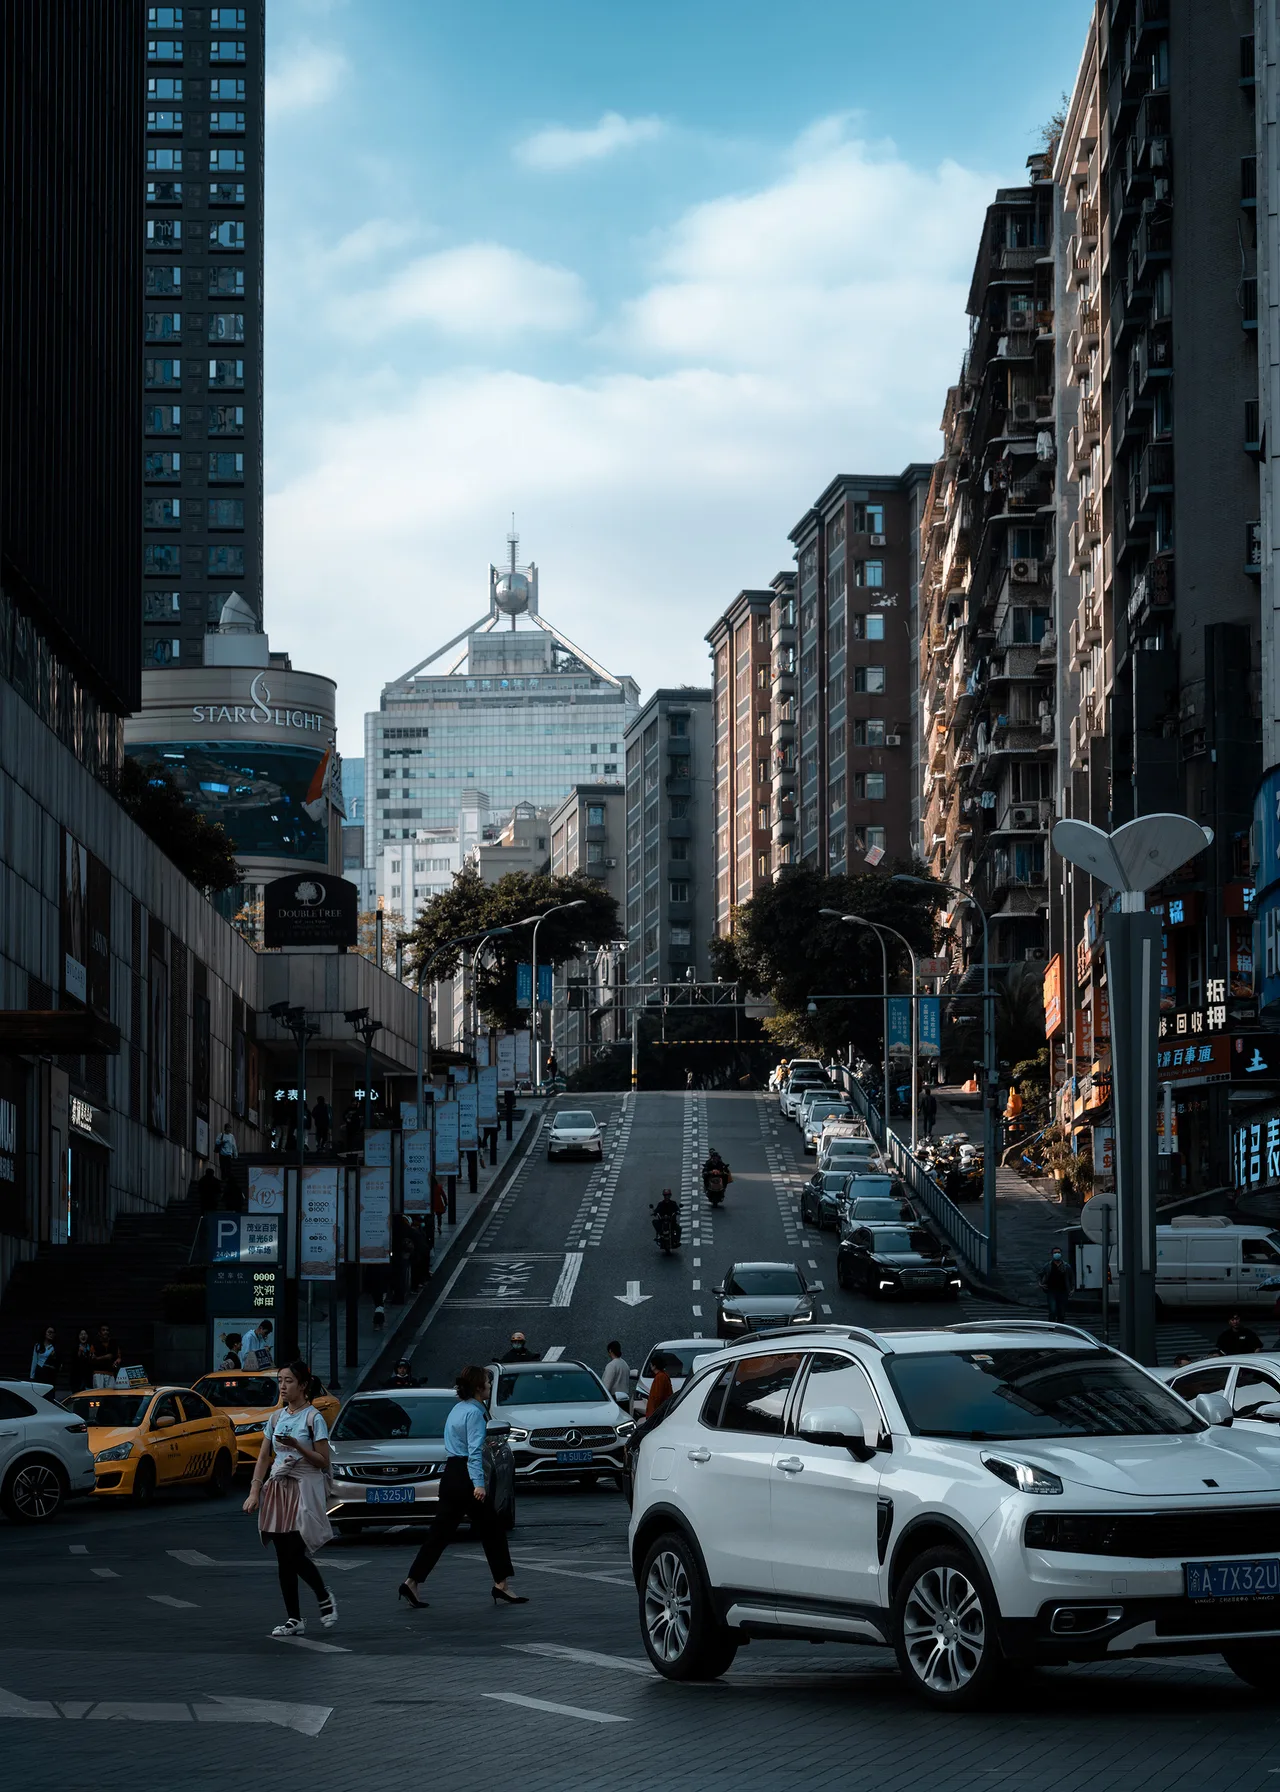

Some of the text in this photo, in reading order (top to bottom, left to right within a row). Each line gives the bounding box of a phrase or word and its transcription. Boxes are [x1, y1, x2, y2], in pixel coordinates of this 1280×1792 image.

[192, 705, 324, 732] STAR LIGHT
[1206, 978, 1227, 1031] 抵押
[1245, 1048, 1268, 1073] 土
[354, 1089, 379, 1101] 中心
[217, 1219, 238, 1248] P
[246, 1223, 277, 1232] 茂业百货
[248, 1234, 274, 1243] 星光68
[248, 1246, 272, 1255] 停车场
[253, 1284, 275, 1296] 欢迎
[253, 1297, 275, 1307] 使用
[1190, 1565, 1278, 1592] 渝A·7X32U
